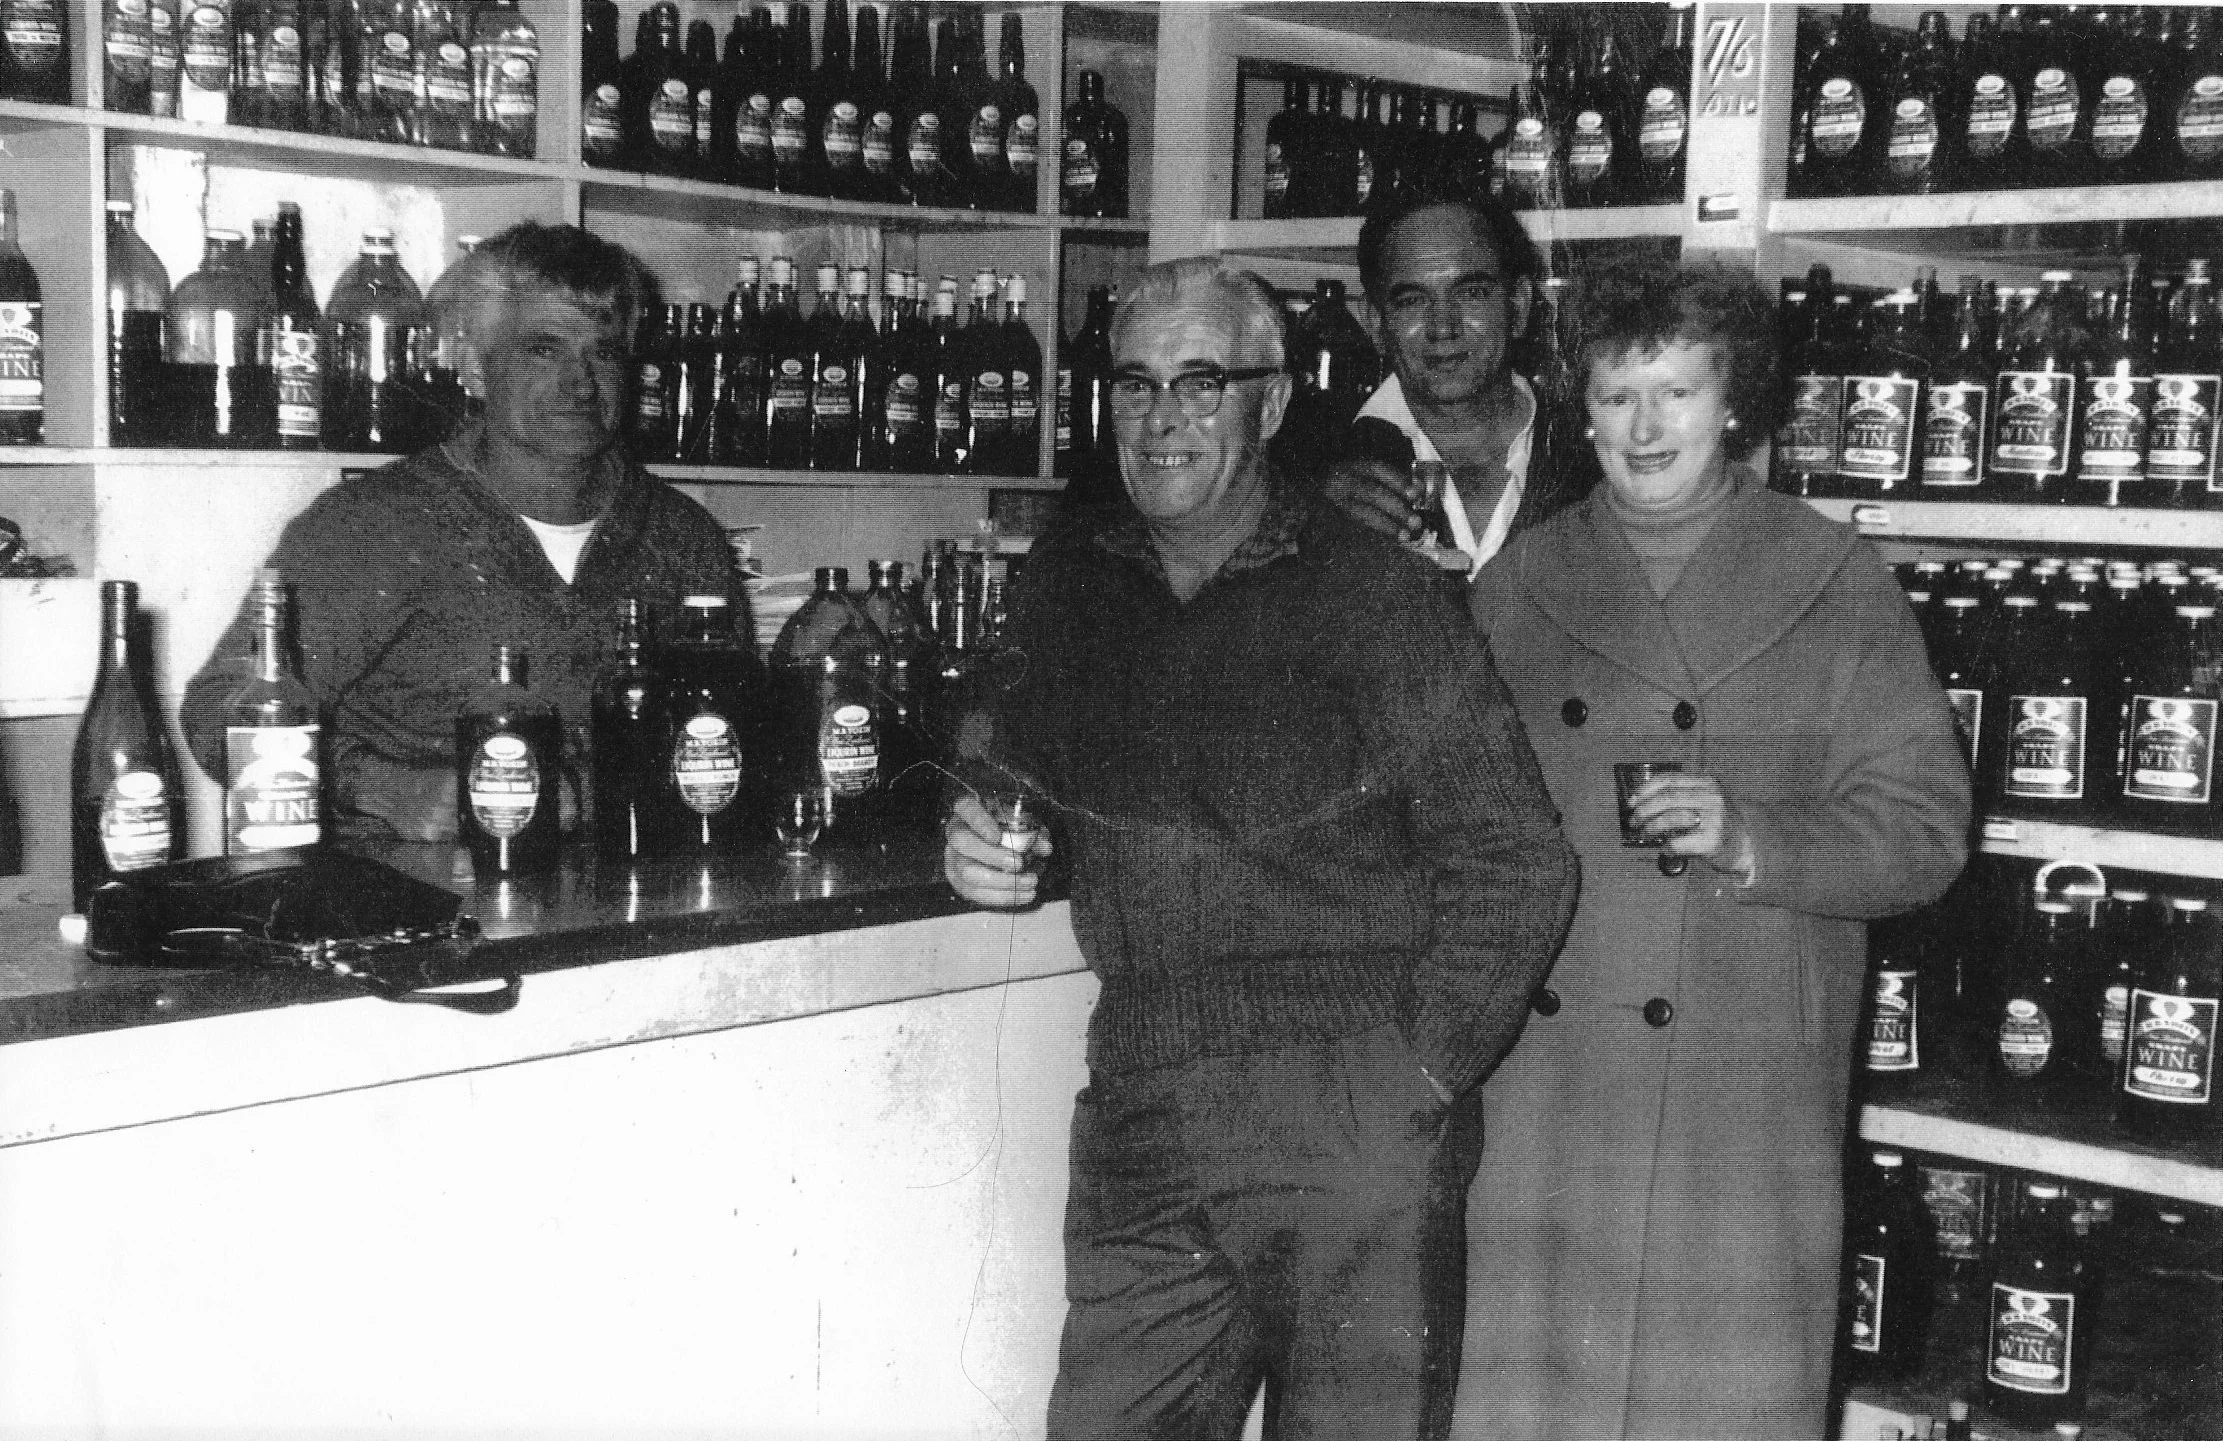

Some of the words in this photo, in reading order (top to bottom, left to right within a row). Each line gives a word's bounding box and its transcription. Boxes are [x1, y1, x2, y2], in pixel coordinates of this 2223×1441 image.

[1704, 16, 1756, 87] 7/6
[0, 360, 39, 377] INE
[1847, 430, 1898, 448] WINE
[2001, 427, 2054, 445] WINE
[2085, 432, 2139, 448] WINE
[2014, 749, 2069, 766] WINE
[2138, 750, 2197, 771] WINE
[243, 799, 318, 822] WINE
[1873, 1022, 1907, 1040] INE
[2138, 1045, 2199, 1071] WINE
[1999, 1338, 2056, 1362] WINE
